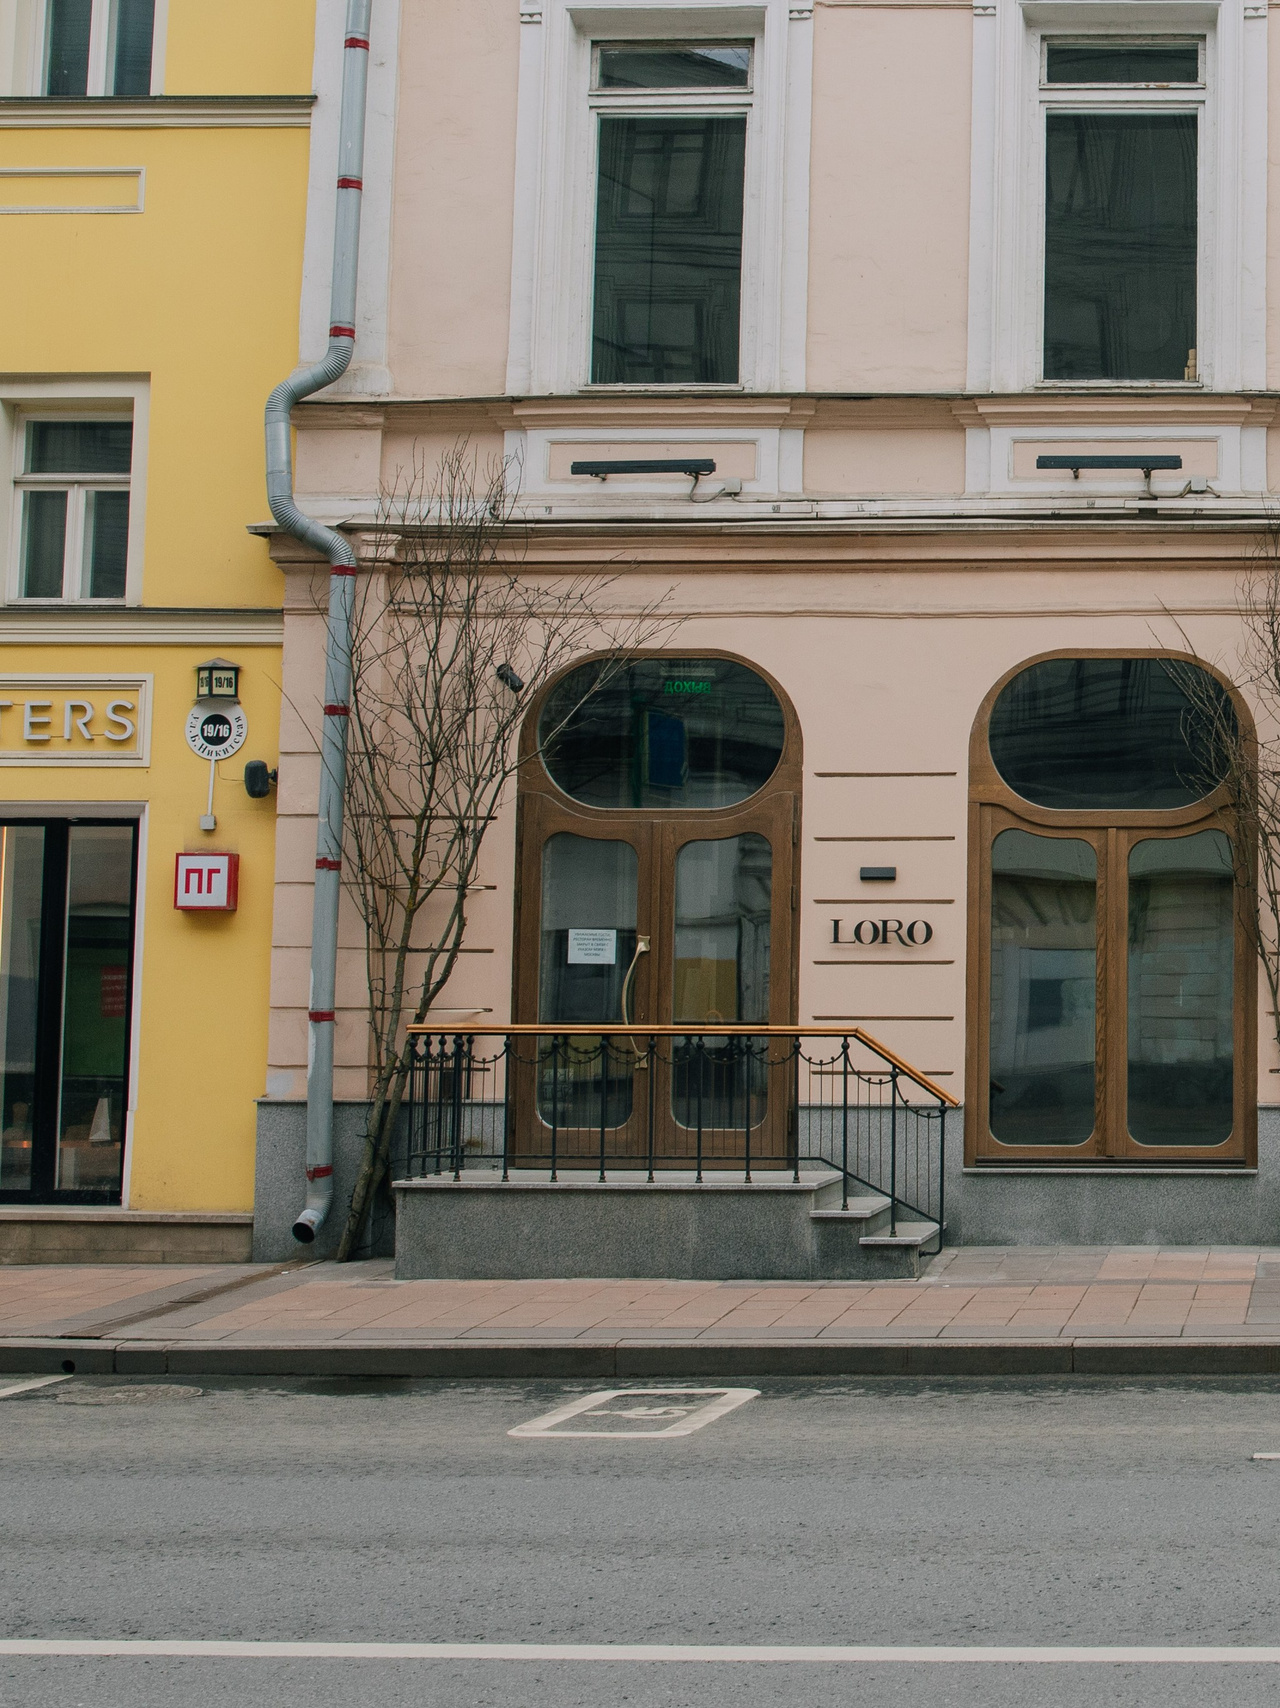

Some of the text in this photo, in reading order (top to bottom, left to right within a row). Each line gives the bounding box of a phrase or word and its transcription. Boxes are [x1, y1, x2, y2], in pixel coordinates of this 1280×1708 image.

[214, 676, 233, 689] 19/16
[198, 716, 243, 757] Никитская
[203, 724, 230, 737] 19/16
[829, 919, 933, 947] LORO
